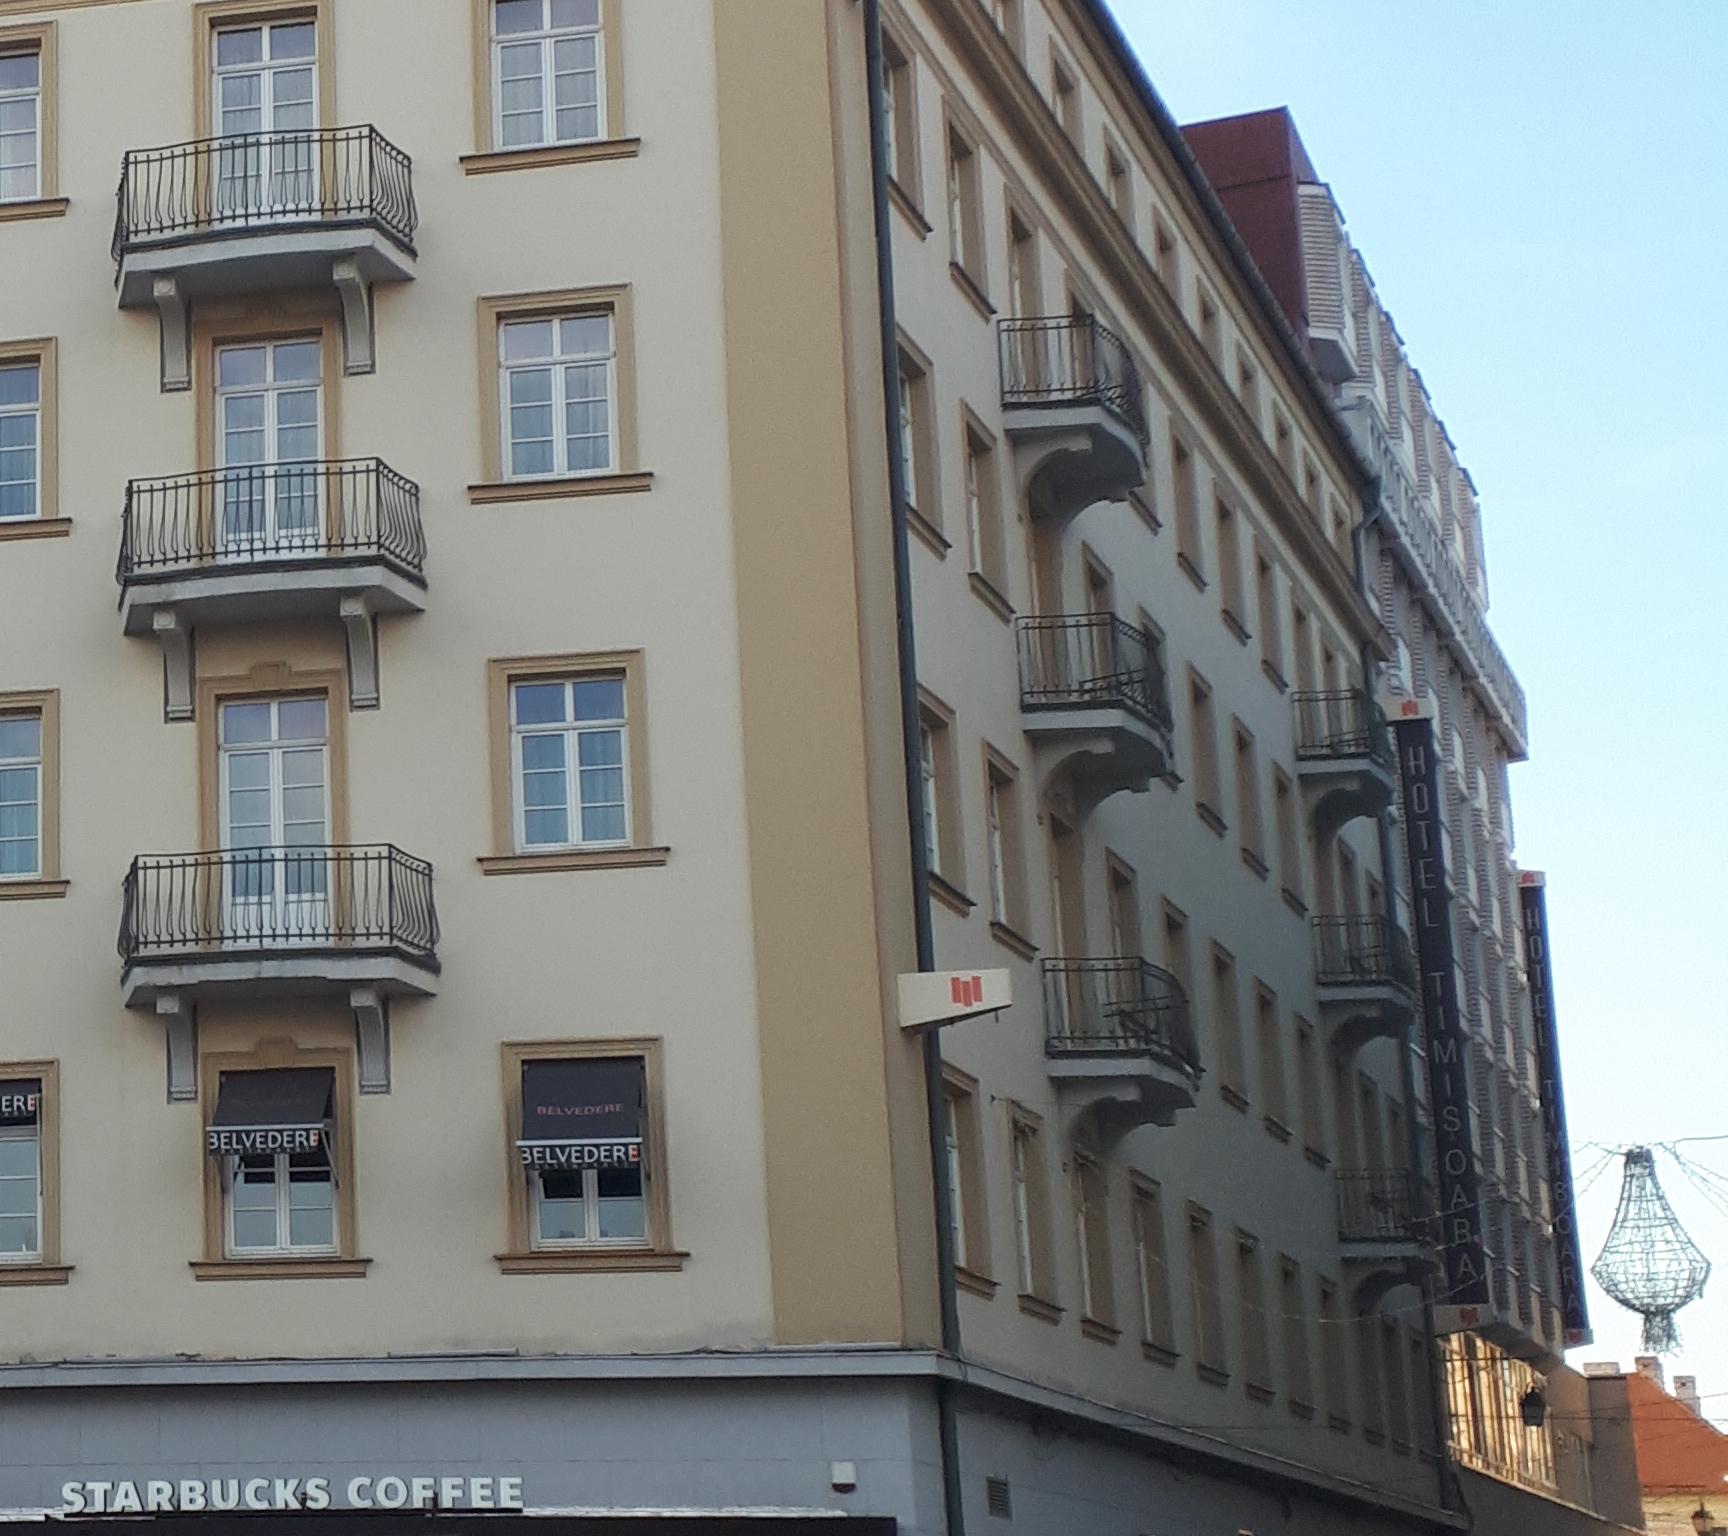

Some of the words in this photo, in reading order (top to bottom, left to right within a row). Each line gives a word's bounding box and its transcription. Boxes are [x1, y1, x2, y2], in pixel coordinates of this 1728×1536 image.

[1407, 743, 1441, 928] HOTEL
[209, 1129, 319, 1150] BELVEDERE
[521, 1144, 639, 1165] BELVEDERE
[60, 1477, 332, 1514] STARBUCKS
[347, 1475, 524, 1510] COFFEE
